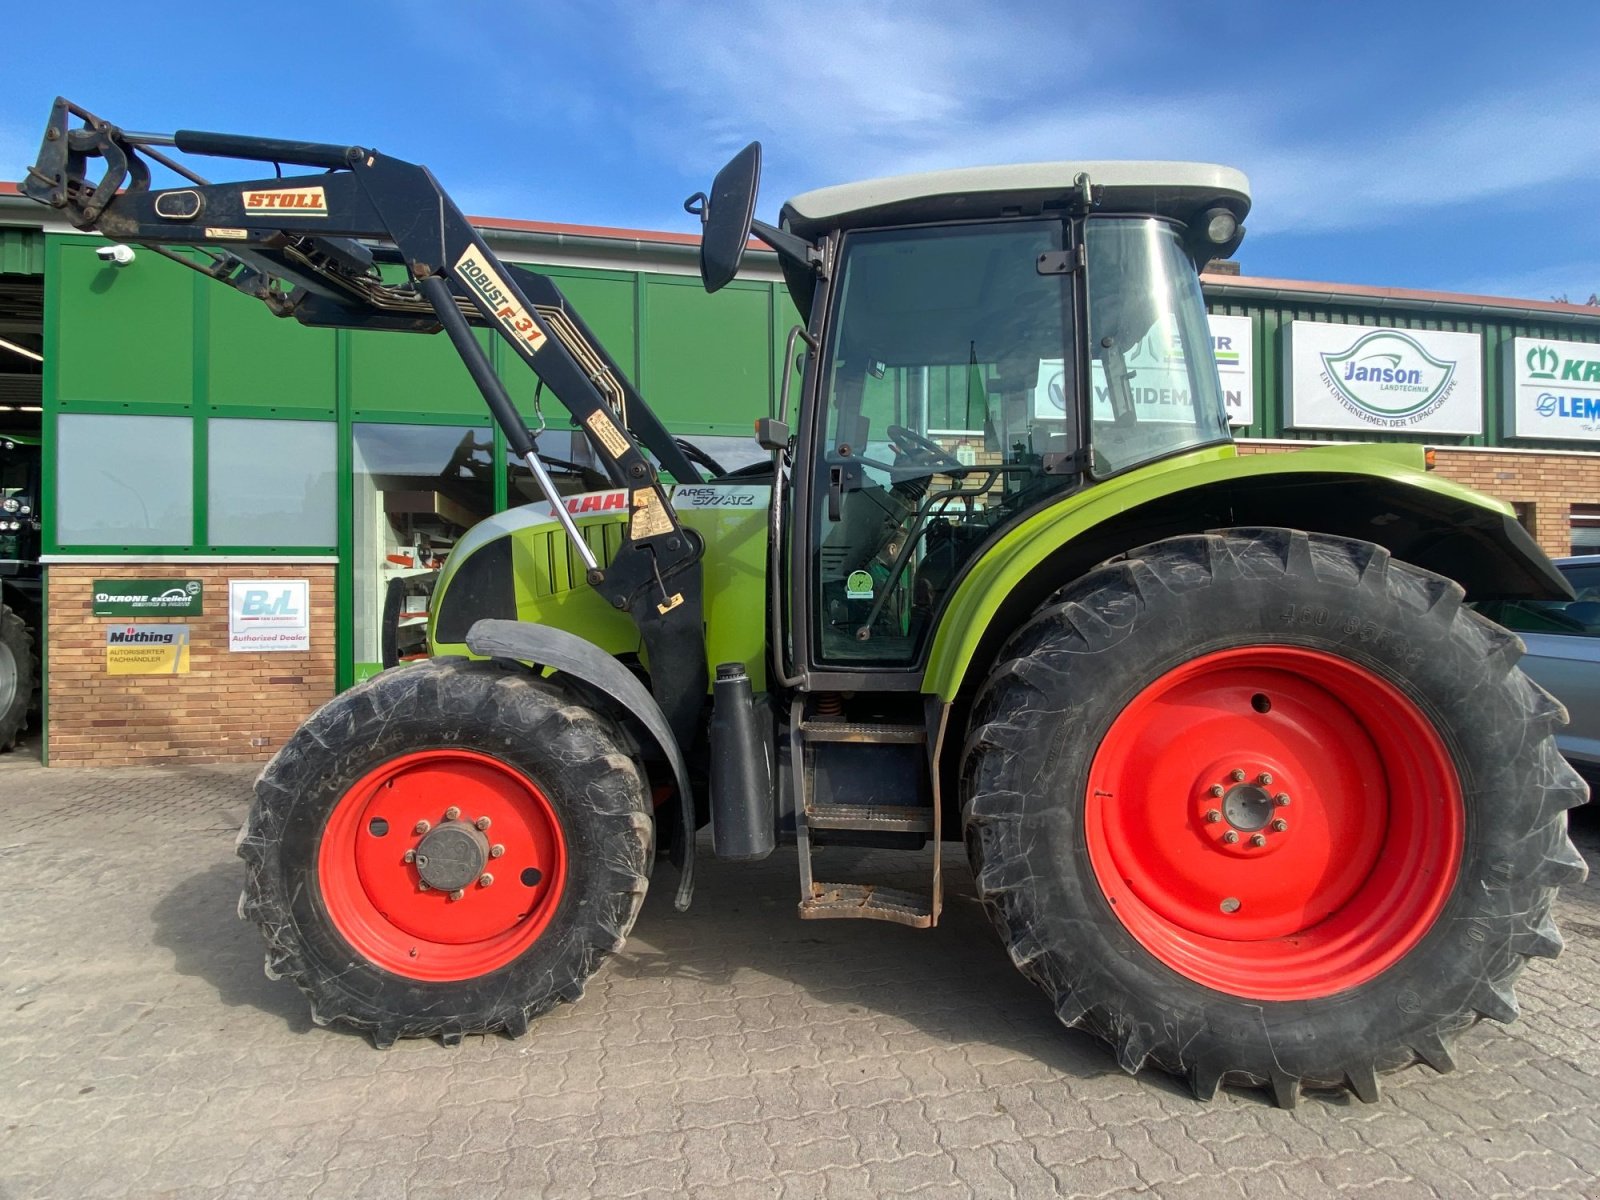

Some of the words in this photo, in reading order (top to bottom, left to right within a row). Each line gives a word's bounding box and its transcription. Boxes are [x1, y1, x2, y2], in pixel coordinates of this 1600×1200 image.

[247, 193, 323, 209] STOLL
[461, 257, 509, 307] ROBUST
[496, 306, 516, 319] F
[515, 317, 542, 342] 31
[1344, 361, 1421, 385] Janson
[1380, 384, 1430, 393] LANDTECHNIK
[1319, 371, 1333, 389] EIN
[1330, 387, 1388, 427] UNTERNEHMEN
[1389, 419, 1407, 428] DER
[1408, 379, 1458, 425] TUPAG-GRUPPE
[677, 488, 716, 497] ARES
[549, 493, 629, 517] LAA
[108, 595, 149, 603] KRONE
[110, 628, 174, 644] Müthing
[232, 634, 278, 642] Authorized
[110, 648, 165, 656] AUTORISIERTER
